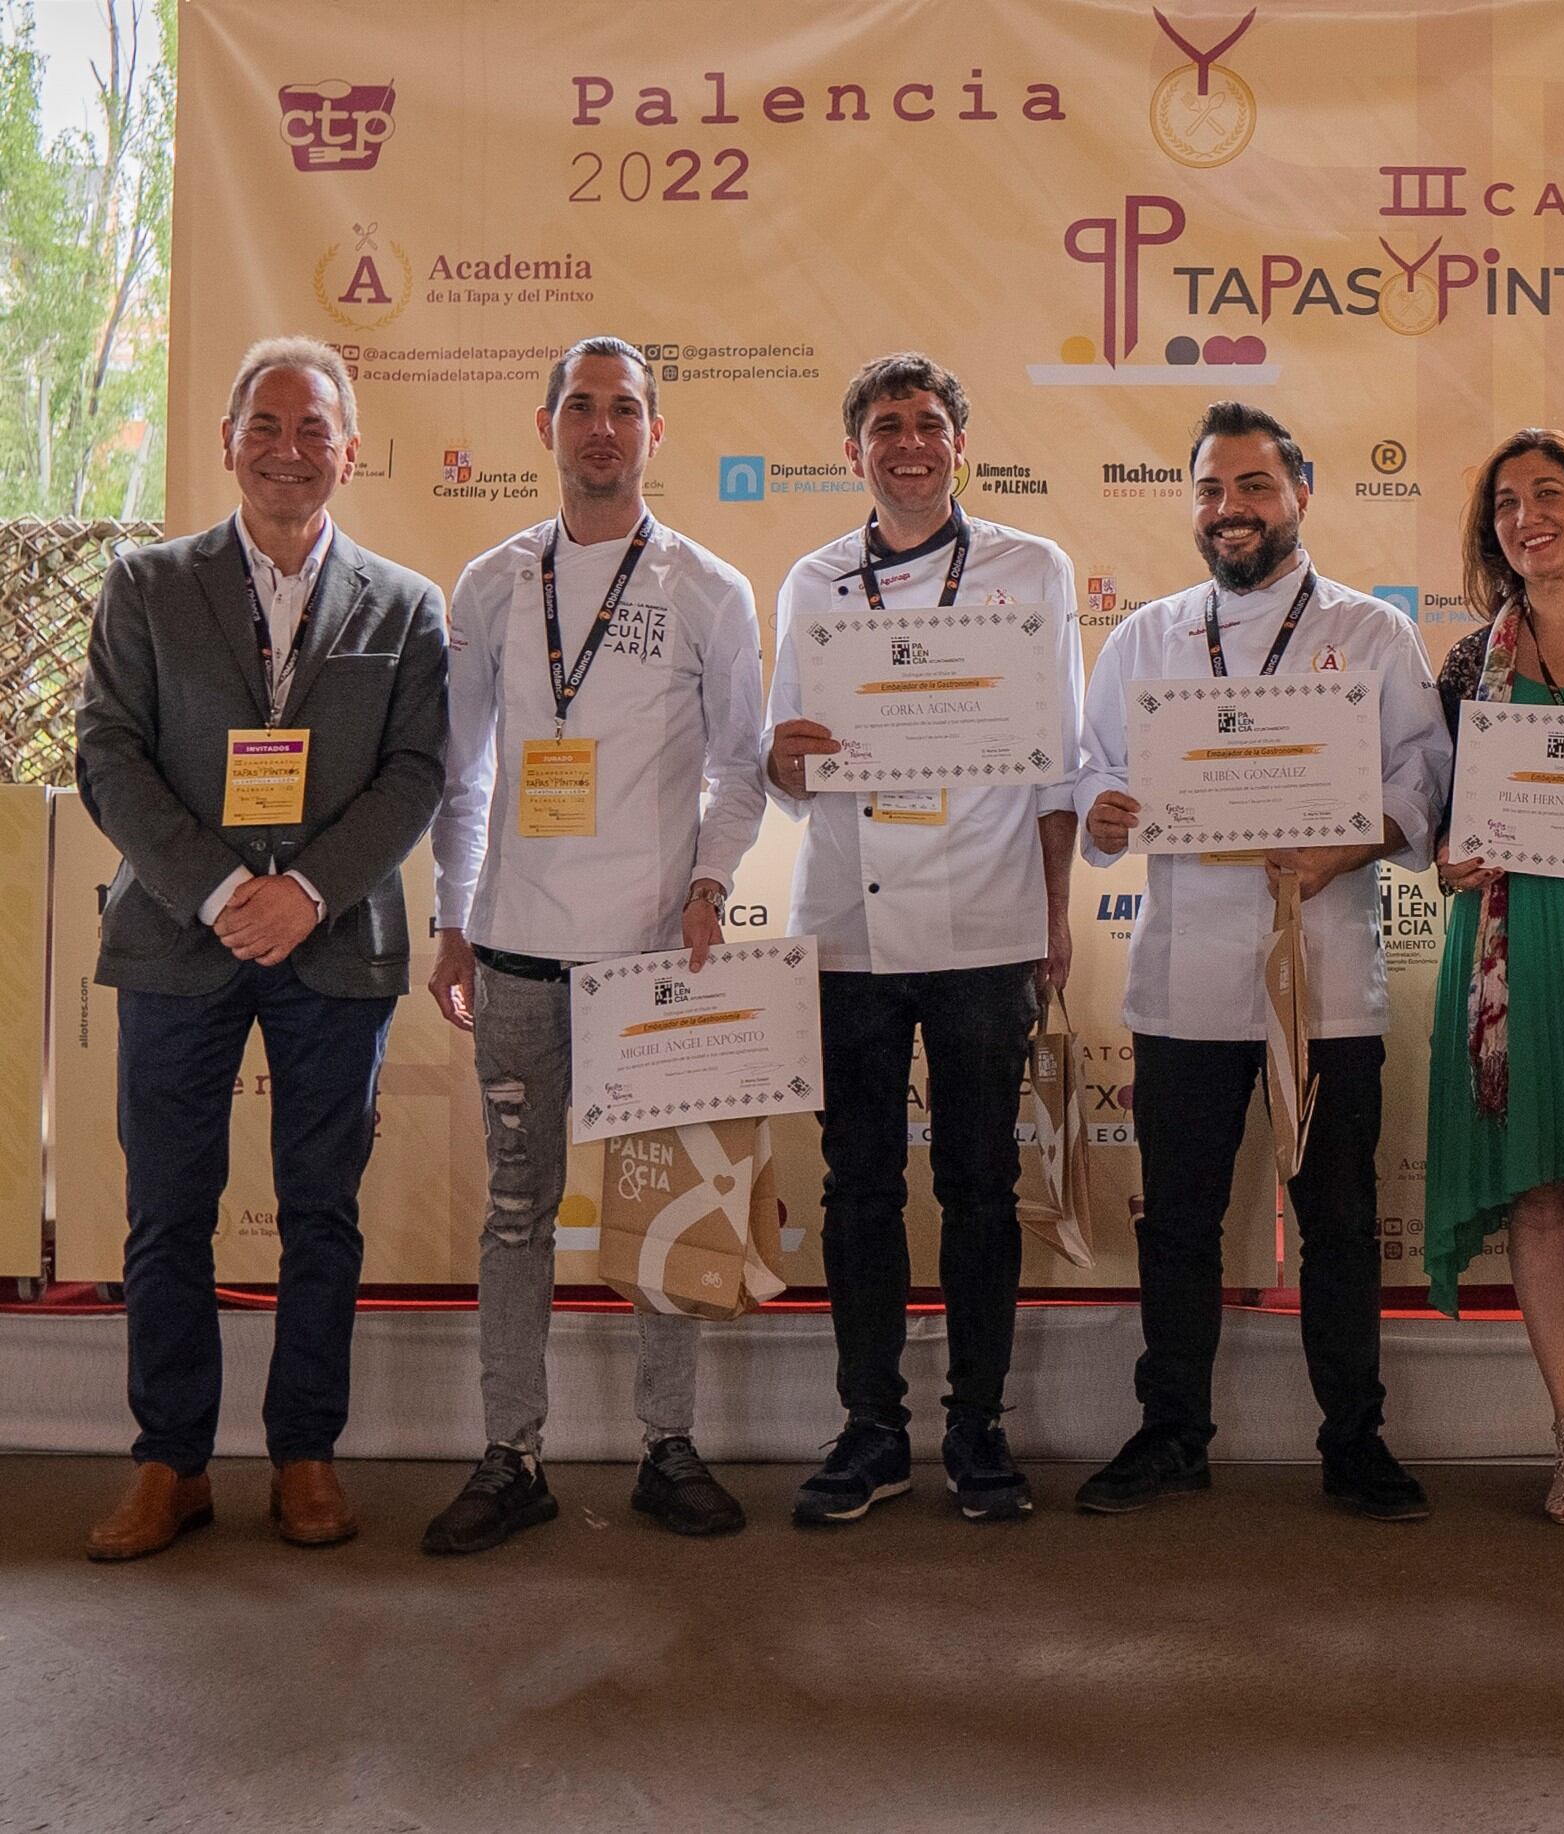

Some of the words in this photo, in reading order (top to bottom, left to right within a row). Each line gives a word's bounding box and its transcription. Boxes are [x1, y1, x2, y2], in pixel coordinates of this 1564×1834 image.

[572, 68, 1066, 126] Palencia
[569, 148, 749, 202] 2022
[1379, 166, 1467, 216] III
[427, 254, 593, 281] Academia
[426, 290, 445, 303] de
[448, 290, 460, 303] la
[464, 289, 500, 306] Tapa
[503, 293, 513, 306] y
[518, 288, 540, 302] del
[544, 287, 594, 303] Pintxo
[682, 343, 815, 361] @gastropalencia
[363, 367, 540, 383] academiadelatapa.com
[682, 364, 820, 382] gastropalencia.es
[475, 471, 516, 483] Junta
[520, 471, 539, 483] de
[771, 462, 847, 480] Diputación
[976, 463, 1031, 479] Alimentos
[1102, 463, 1183, 483] Mahou
[433, 484, 486, 498] Castilla
[491, 489, 500, 501] y
[503, 484, 539, 498] León
[771, 482, 790, 493] DE
[795, 481, 866, 494] PALENCIA
[982, 484, 993, 494] de
[995, 479, 1048, 495] PALENCIA
[1103, 489, 1147, 497] DESDE
[1152, 489, 1183, 497] 1890
[1356, 482, 1422, 496] RUEDA
[605, 573, 628, 609] Oblanca
[1289, 592, 1309, 620] Oblanca
[1424, 594, 1463, 608] Diput
[1079, 614, 1124, 626] Castill
[570, 649, 593, 687] Oblanca
[880, 704, 923, 717] GORKA
[929, 700, 982, 713] AGINAGA
[246, 745, 290, 753] INVITADOS
[1202, 768, 1240, 783] RUBÉN
[1244, 766, 1306, 780] GONZÁLEZ
[1499, 791, 1529, 804] PILAR
[1398, 885, 1423, 900] PA
[1398, 902, 1437, 918] LEN
[1398, 920, 1433, 936] CIA
[79, 976, 89, 1049] allotres.com
[620, 1045, 660, 1060] MIGUEL
[665, 1038, 704, 1053] ÁNGEL
[707, 1030, 765, 1047] EXPÓSITO
[609, 1137, 674, 1167] PALEN
